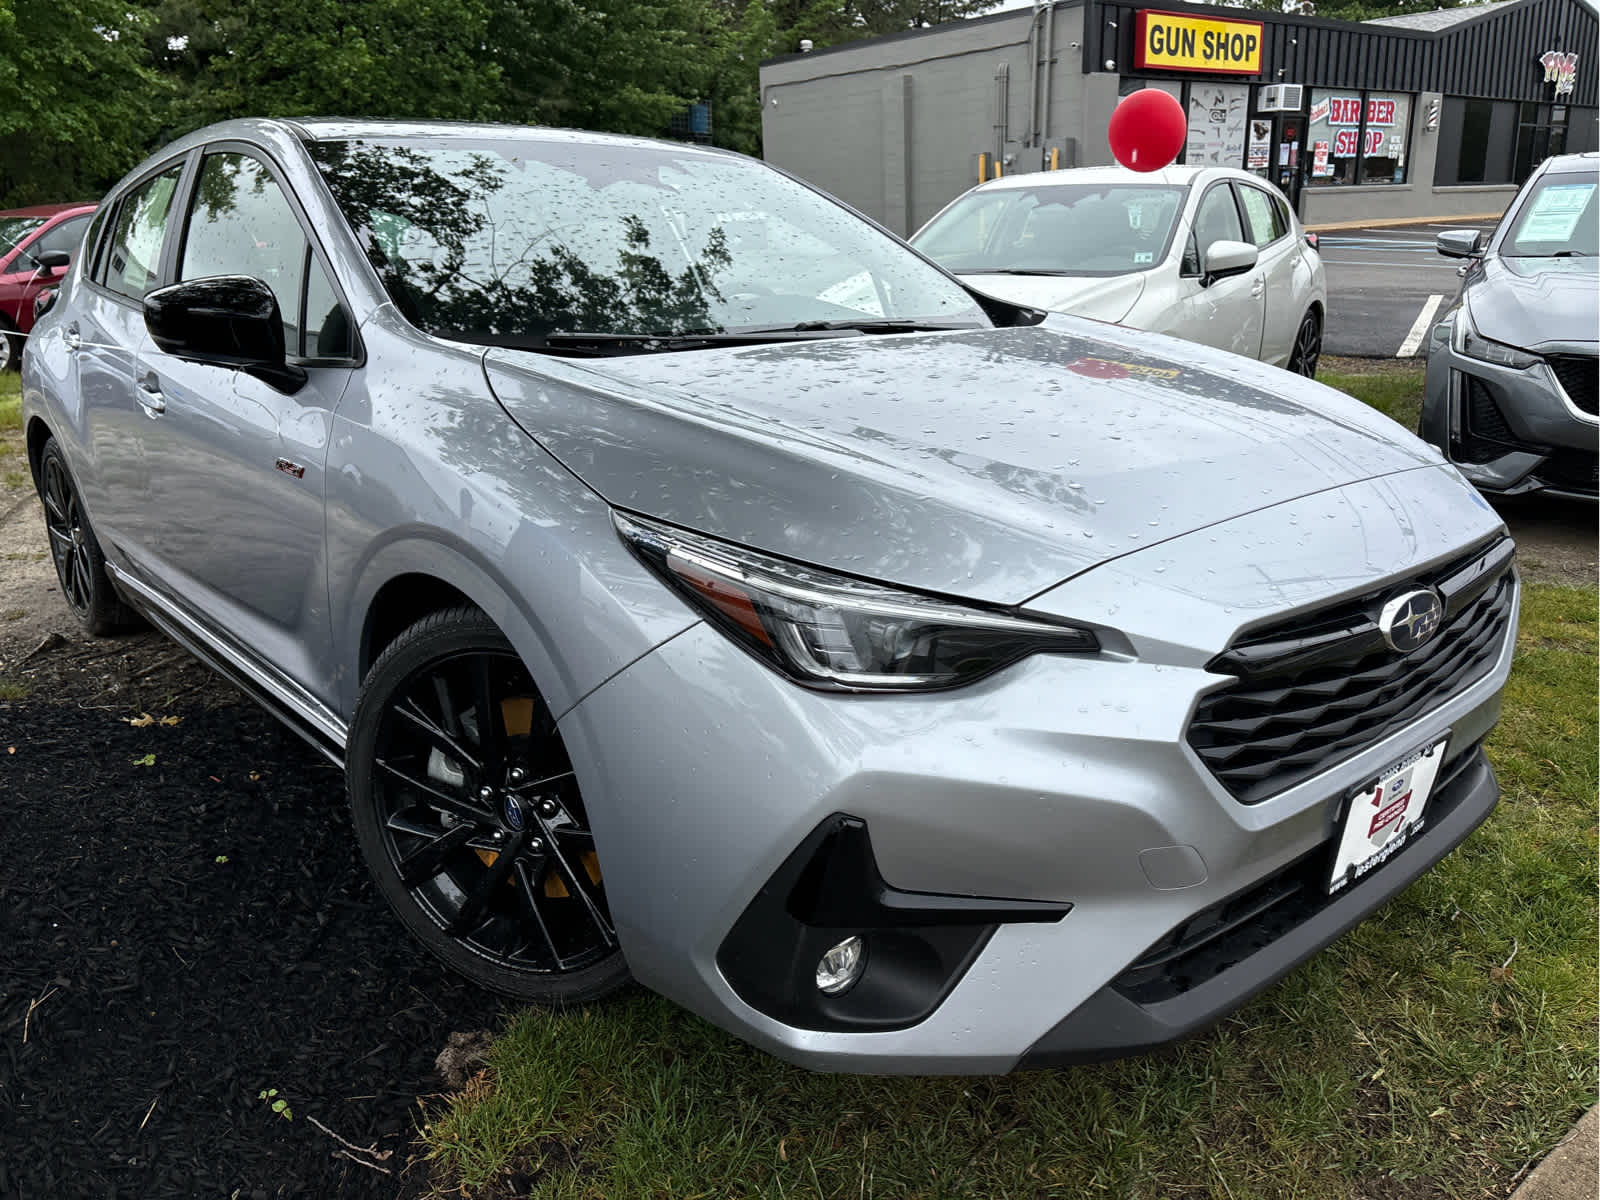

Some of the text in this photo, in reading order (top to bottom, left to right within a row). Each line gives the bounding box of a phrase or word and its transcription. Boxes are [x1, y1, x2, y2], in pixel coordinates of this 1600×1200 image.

[1149, 24, 1257, 62] GUN SHOP
[1330, 98, 1395, 124] BARBER
[1335, 130, 1383, 155] SHOP
